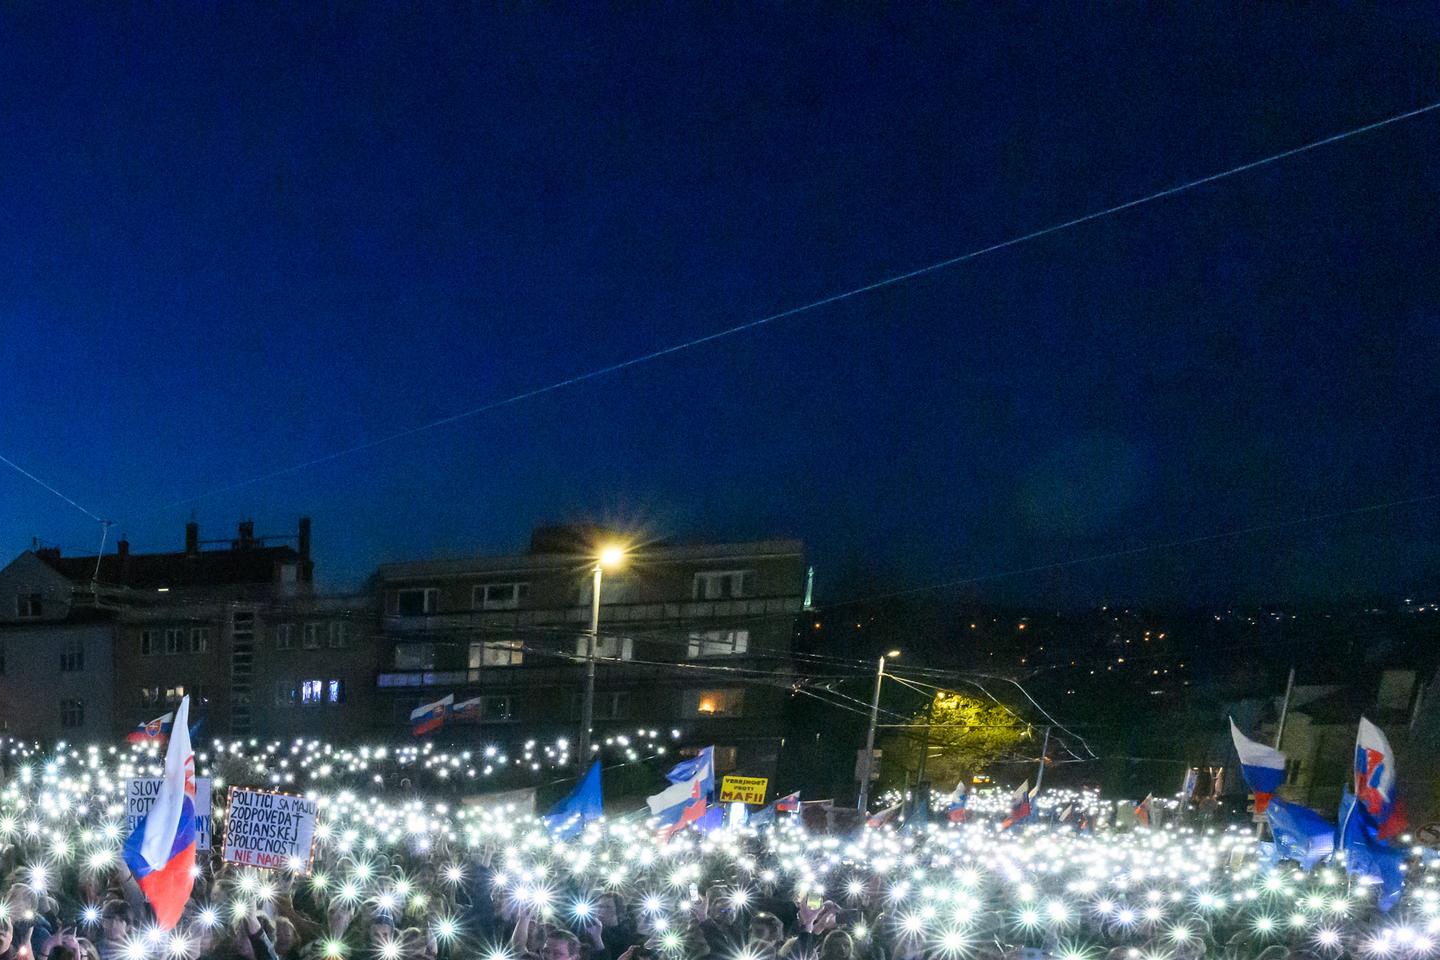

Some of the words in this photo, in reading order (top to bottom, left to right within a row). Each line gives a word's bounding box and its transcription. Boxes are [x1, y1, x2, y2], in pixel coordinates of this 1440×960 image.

[131, 780, 164, 796] SLOV
[231, 790, 274, 809] POLITICI
[277, 798, 290, 811] SA
[721, 791, 763, 802] MAFII
[228, 818, 298, 842] OBČIANSKEJ
[234, 849, 253, 863] NIE
